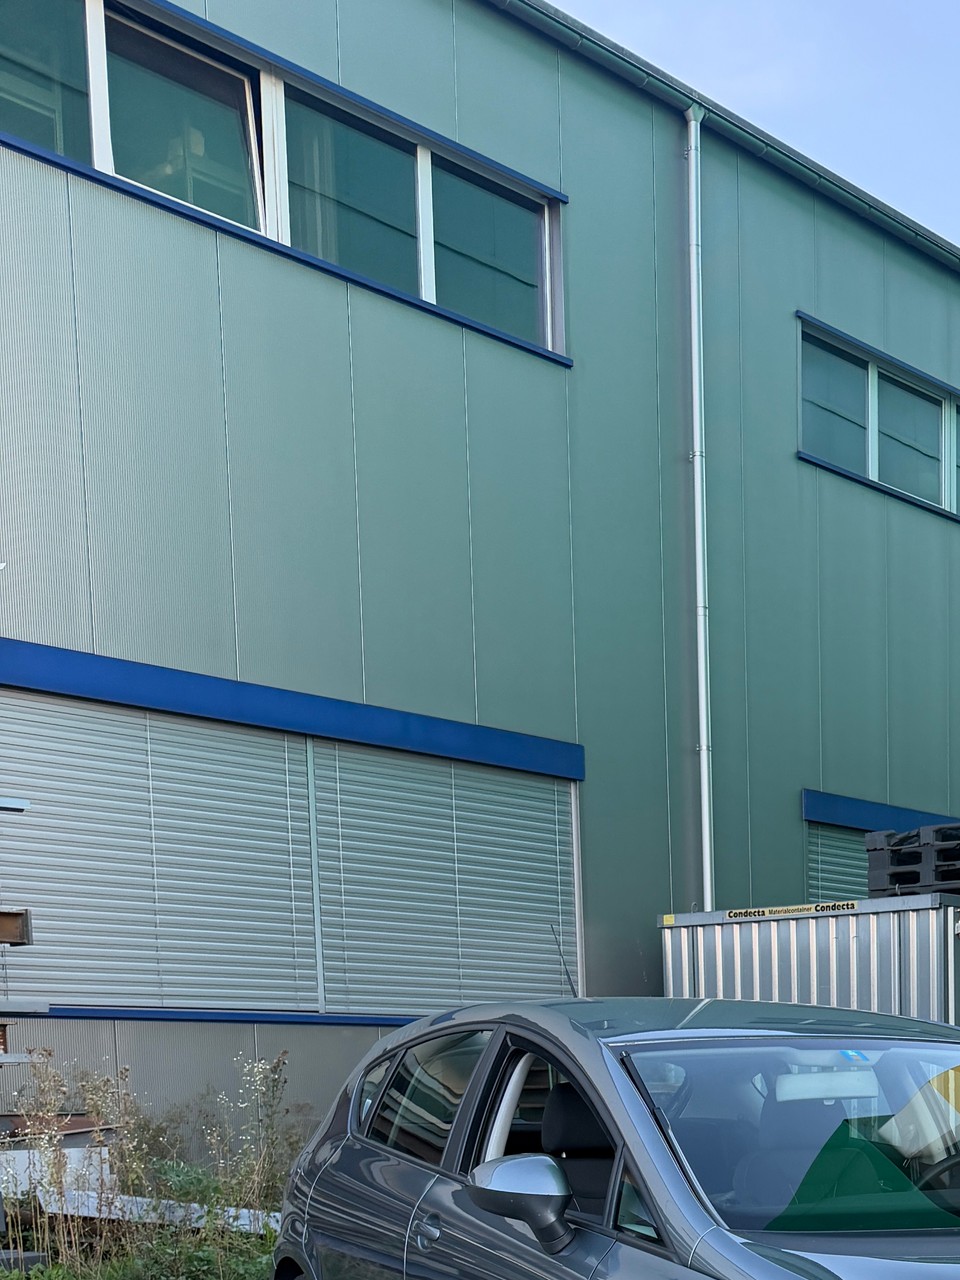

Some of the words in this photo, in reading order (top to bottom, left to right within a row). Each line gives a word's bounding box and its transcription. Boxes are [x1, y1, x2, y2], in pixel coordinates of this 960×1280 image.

[728, 909, 766, 918] Condecta
[768, 907, 812, 915] Materialcontainer
[814, 902, 855, 912] Condecta
